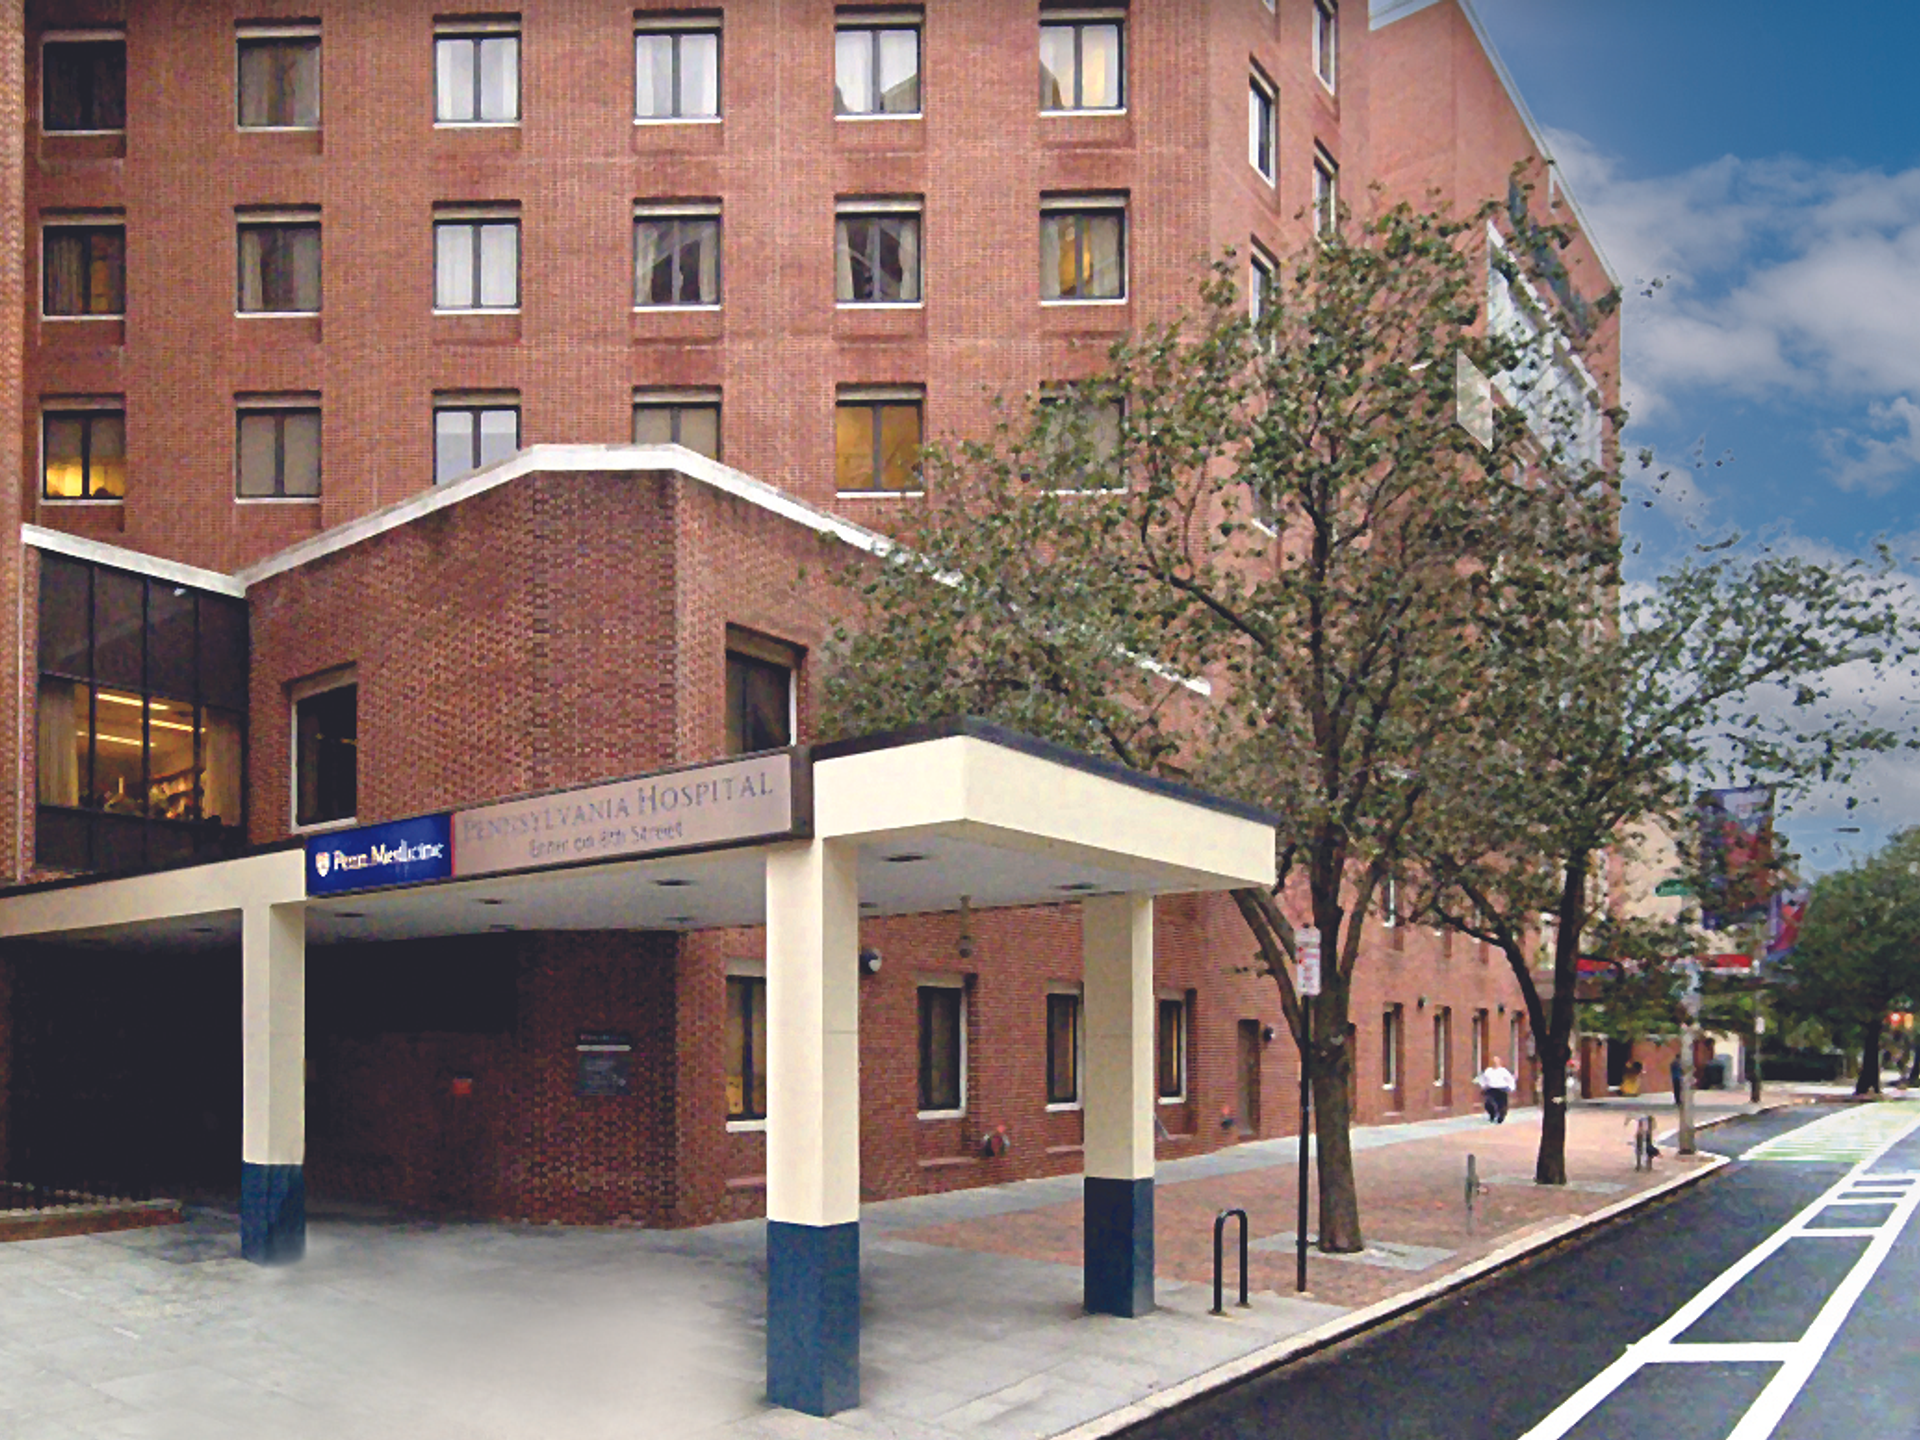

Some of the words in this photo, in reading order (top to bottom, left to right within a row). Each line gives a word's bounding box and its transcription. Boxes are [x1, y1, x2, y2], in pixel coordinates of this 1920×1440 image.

[463, 798, 630, 841] PENNSYLVANIA
[637, 772, 773, 815] HOSPITAL
[630, 821, 683, 843] Street
[333, 850, 368, 871] Penn
[371, 839, 444, 865] Medicine
